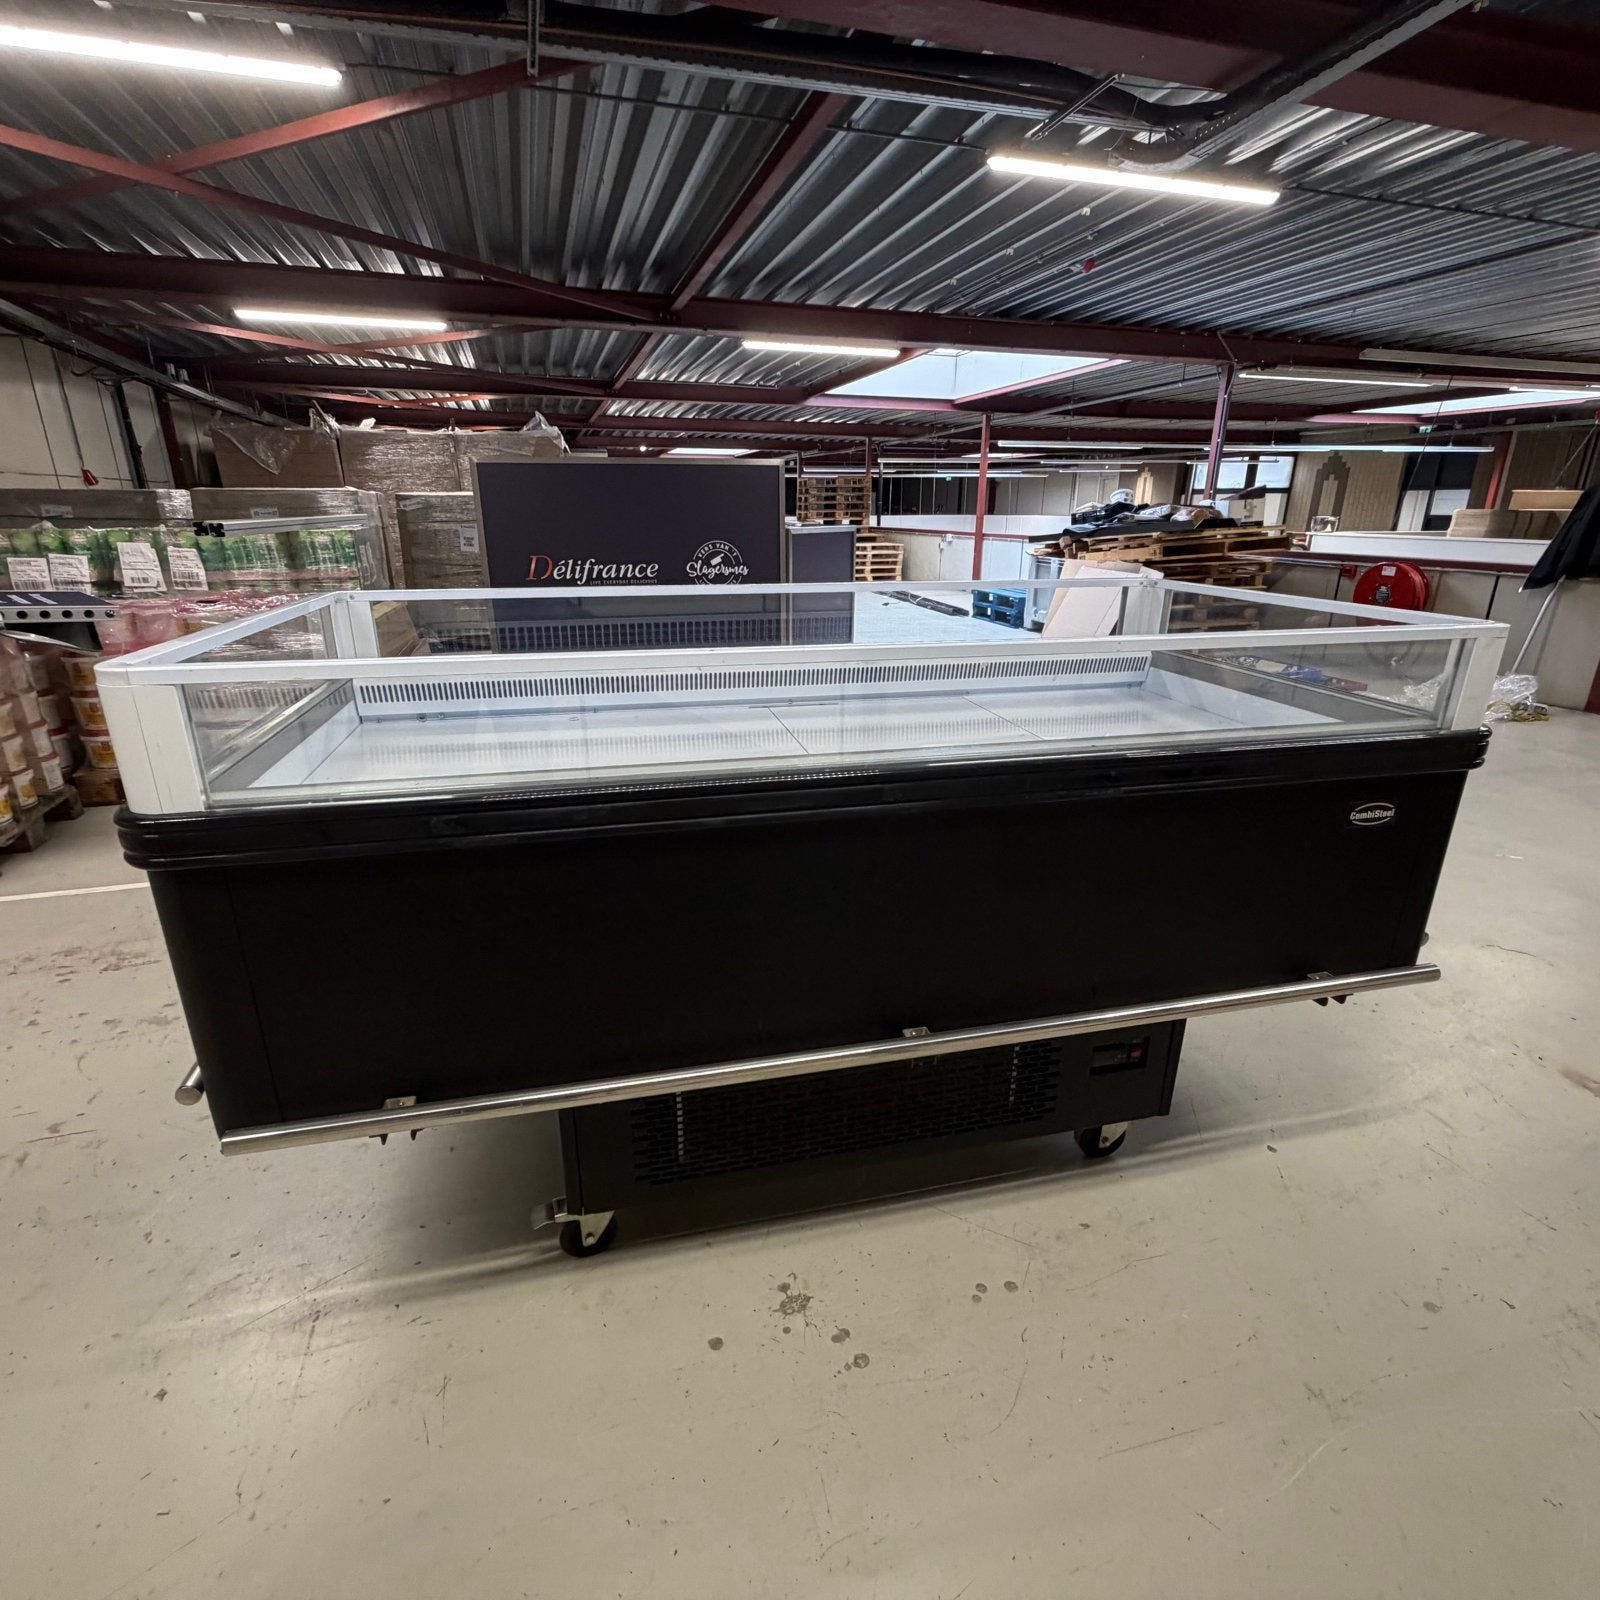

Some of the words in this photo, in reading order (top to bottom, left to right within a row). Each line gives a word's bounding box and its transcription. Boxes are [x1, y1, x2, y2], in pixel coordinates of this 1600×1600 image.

[697, 544, 713, 558] VERS
[715, 543, 730, 551] VAN
[527, 555, 659, 585] Délifrance
[686, 560, 750, 579] Slagersmes
[1350, 808, 1396, 820] CombiSteel
